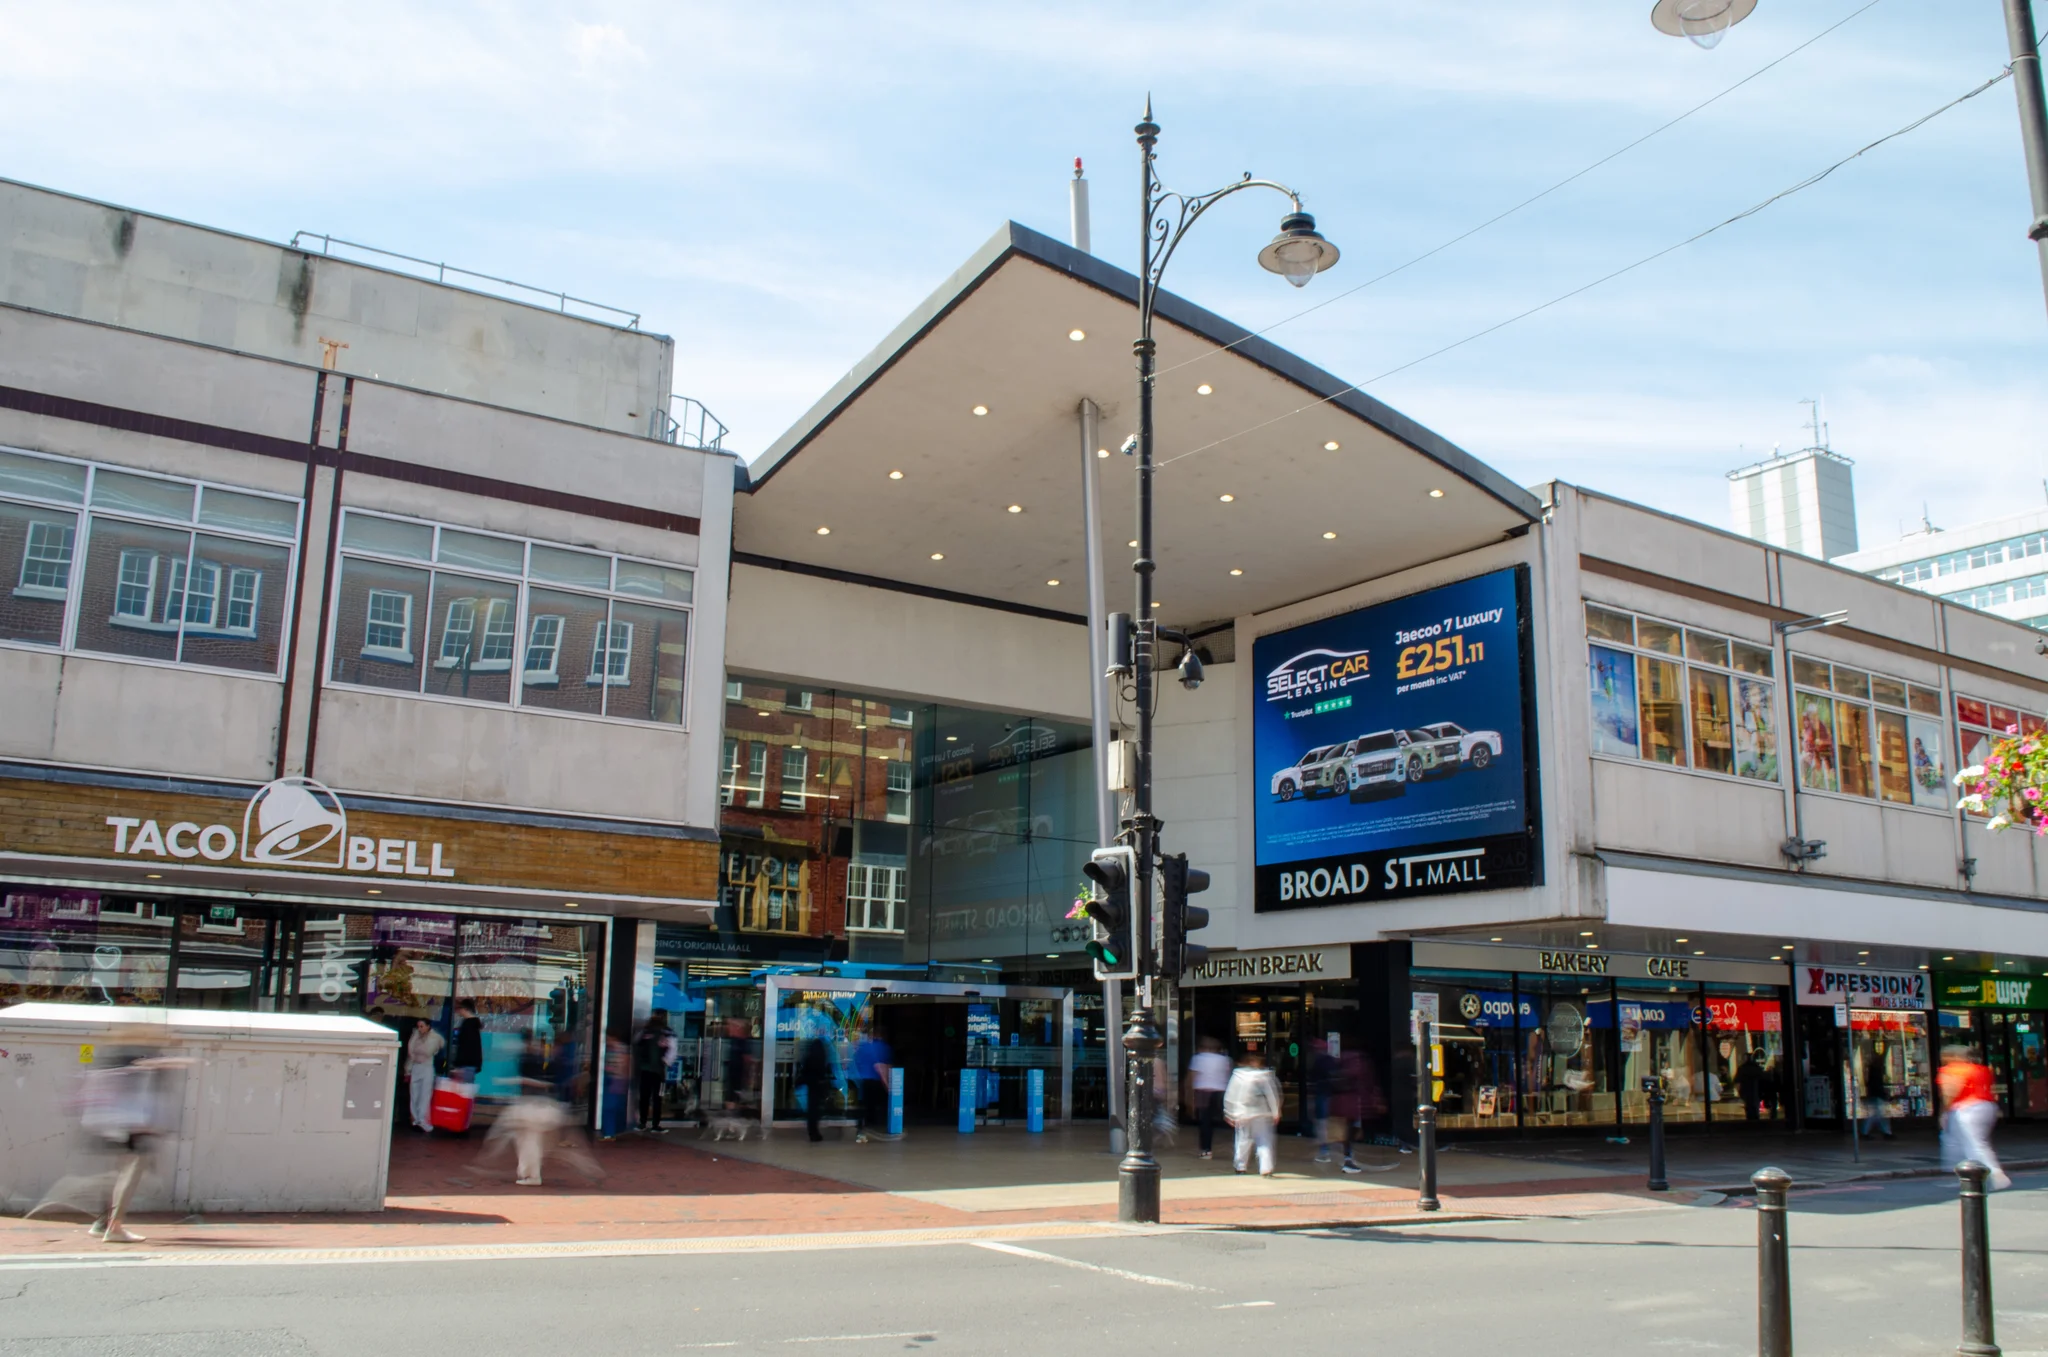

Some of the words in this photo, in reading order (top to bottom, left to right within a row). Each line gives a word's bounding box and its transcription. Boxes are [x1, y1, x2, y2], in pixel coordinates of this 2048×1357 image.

[1396, 622, 1441, 645] Jaecoo
[1443, 618, 1453, 634] 7
[1456, 607, 1503, 630] Luxury
[1396, 634, 1485, 680] £251.11
[1266, 664, 1329, 695] SELECT
[1330, 655, 1369, 679] CAR
[1287, 676, 1348, 700] LEASING
[1396, 685, 1409, 696] per
[1410, 678, 1435, 693] month
[1436, 675, 1448, 686] inc
[106, 816, 237, 861] TACO
[347, 836, 455, 877] BELL
[1280, 863, 1370, 901] BROAD
[1385, 853, 1424, 890] ST.
[1428, 858, 1486, 885] MALL
[684, 941, 726, 951] ORIGINAL
[727, 943, 751, 952] MALL
[1193, 957, 1257, 980] MUFFIN
[1261, 953, 1324, 975] BREAK
[1539, 952, 1609, 973] BAKERY
[1647, 957, 1690, 978] CAFE
[1135, 985, 1146, 996] 15
[1807, 967, 1914, 995] XPRESSION
[1914, 974, 1925, 998] 2
